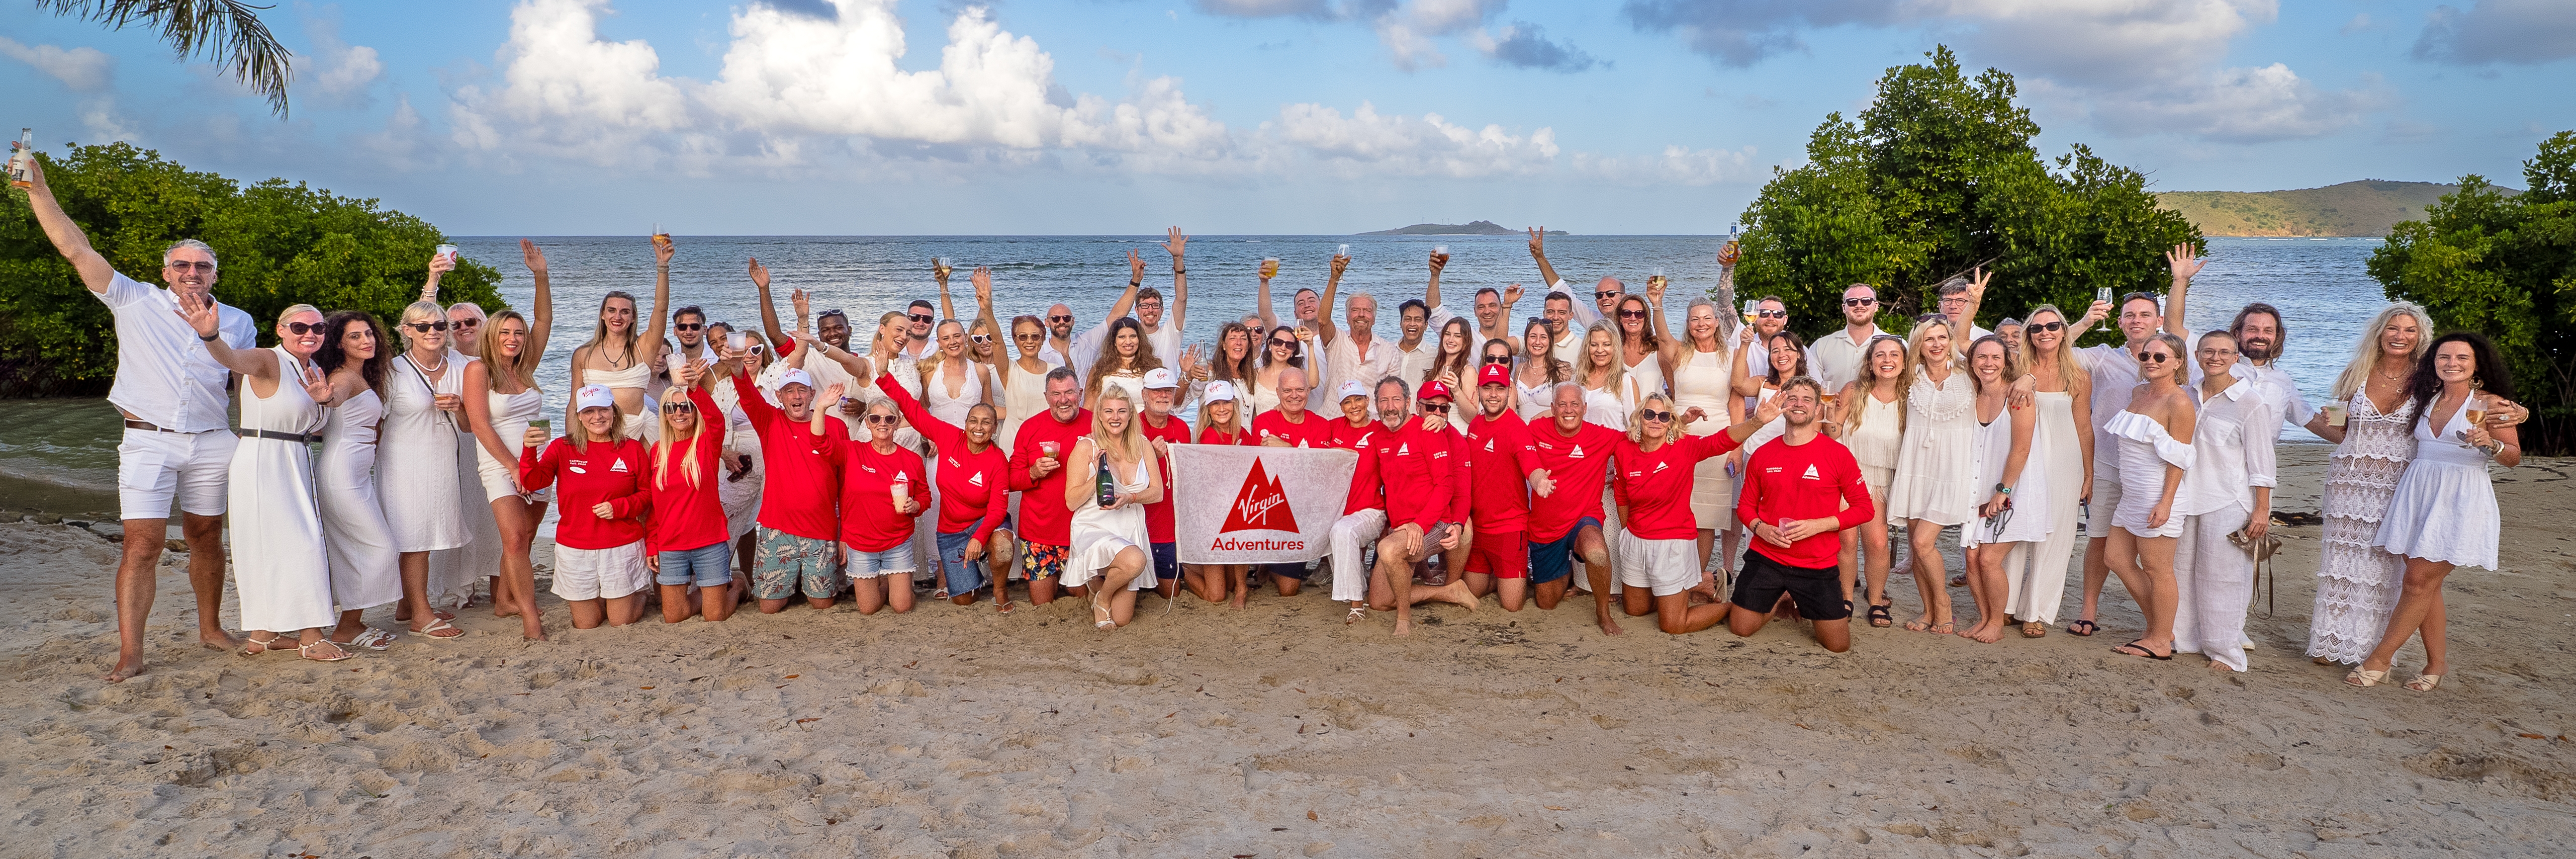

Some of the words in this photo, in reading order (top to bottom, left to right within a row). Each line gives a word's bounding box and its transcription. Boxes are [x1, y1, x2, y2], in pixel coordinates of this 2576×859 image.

[1157, 371, 1167, 380] Virgin
[582, 387, 600, 397] Virgin
[1209, 383, 1223, 393] Virgin
[1238, 484, 1284, 526] Virgin
[1211, 537, 1304, 551] Adventures
